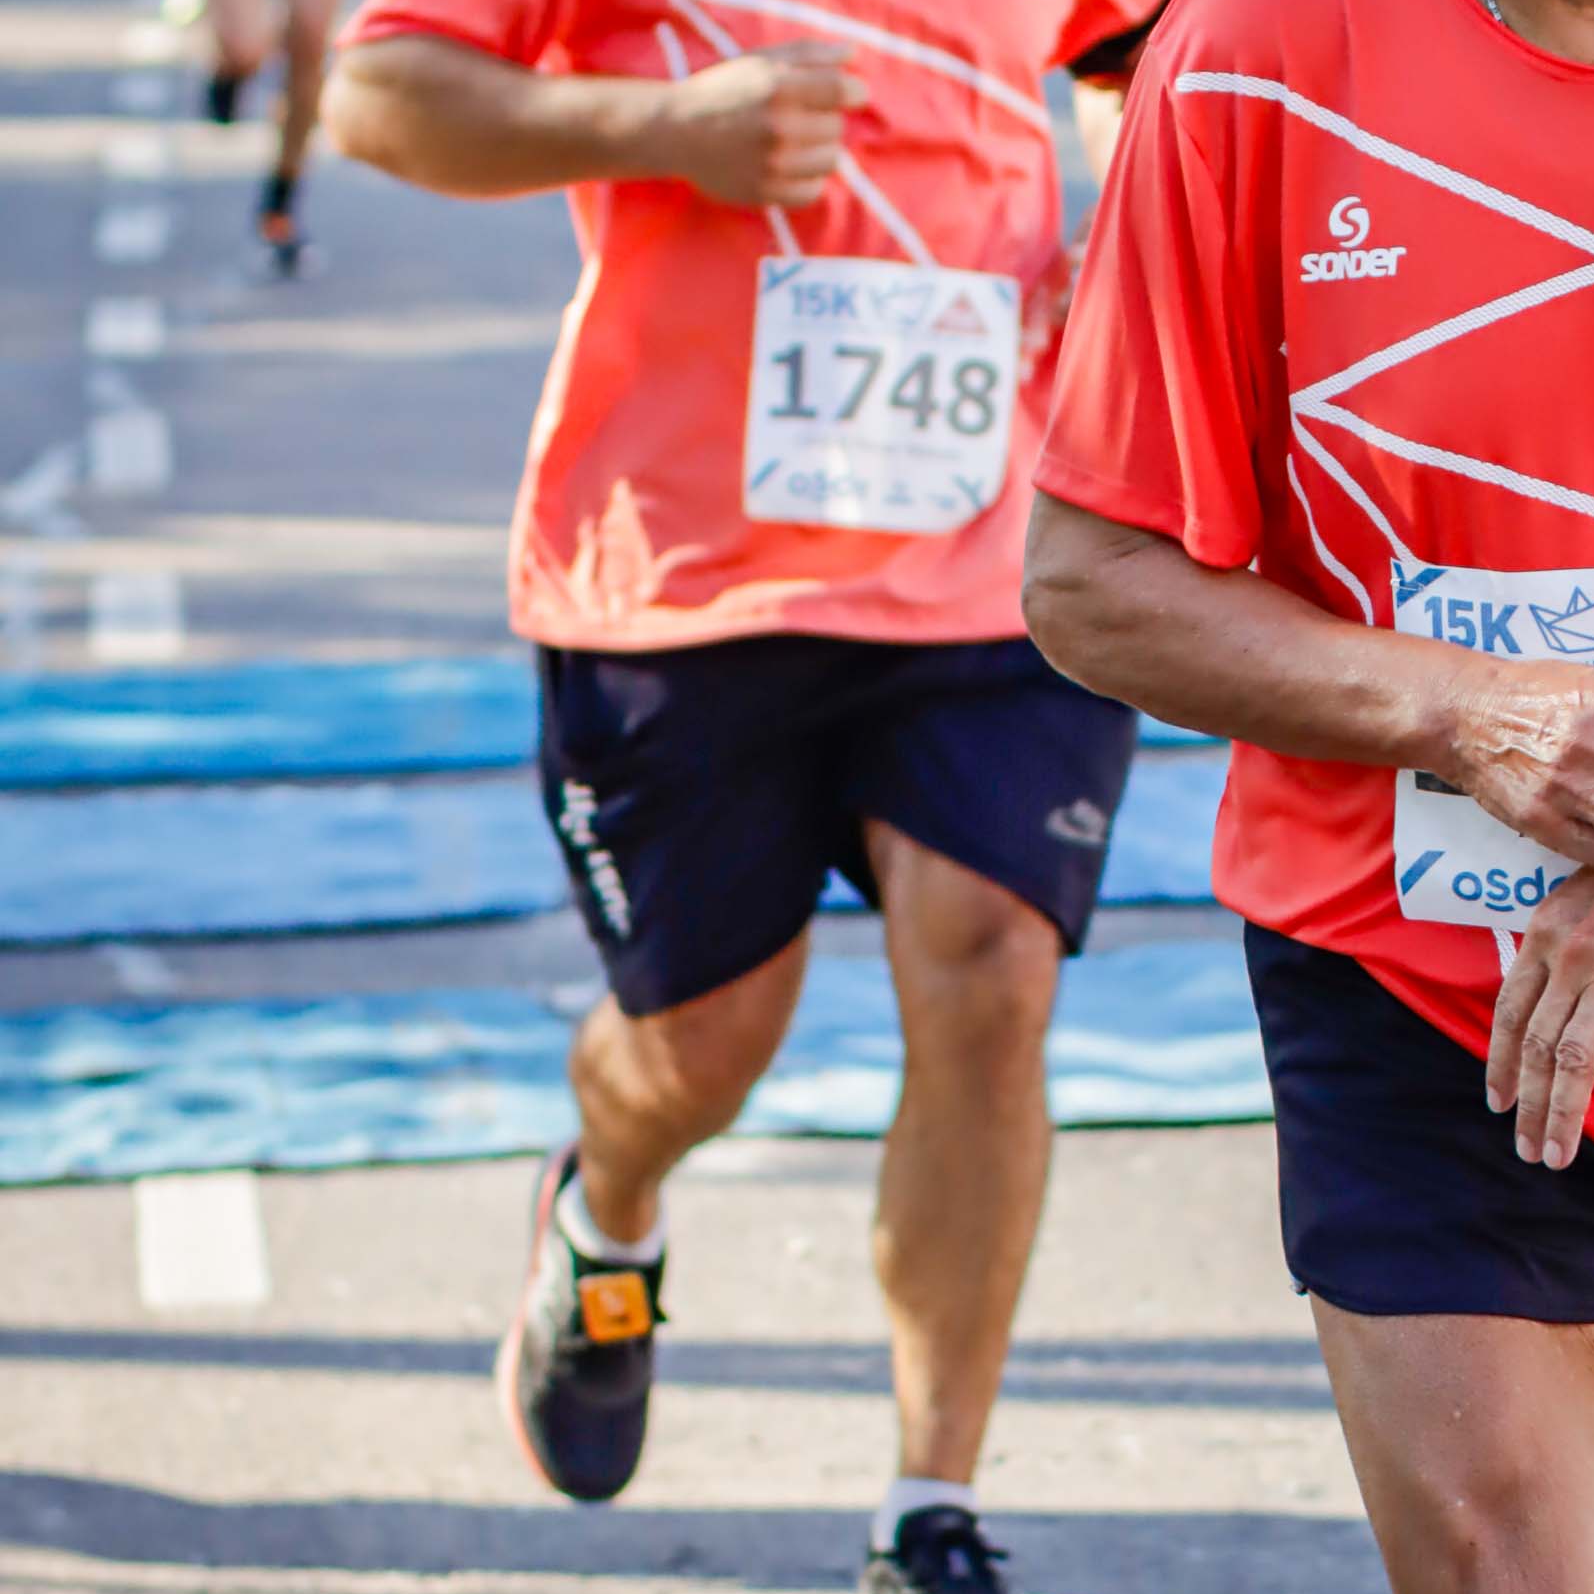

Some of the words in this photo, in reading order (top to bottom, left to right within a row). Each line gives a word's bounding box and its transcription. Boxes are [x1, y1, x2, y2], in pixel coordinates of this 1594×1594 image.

[791, 281, 859, 319] 15K
[769, 341, 998, 436] 1748
[1424, 595, 1523, 654] 15K
